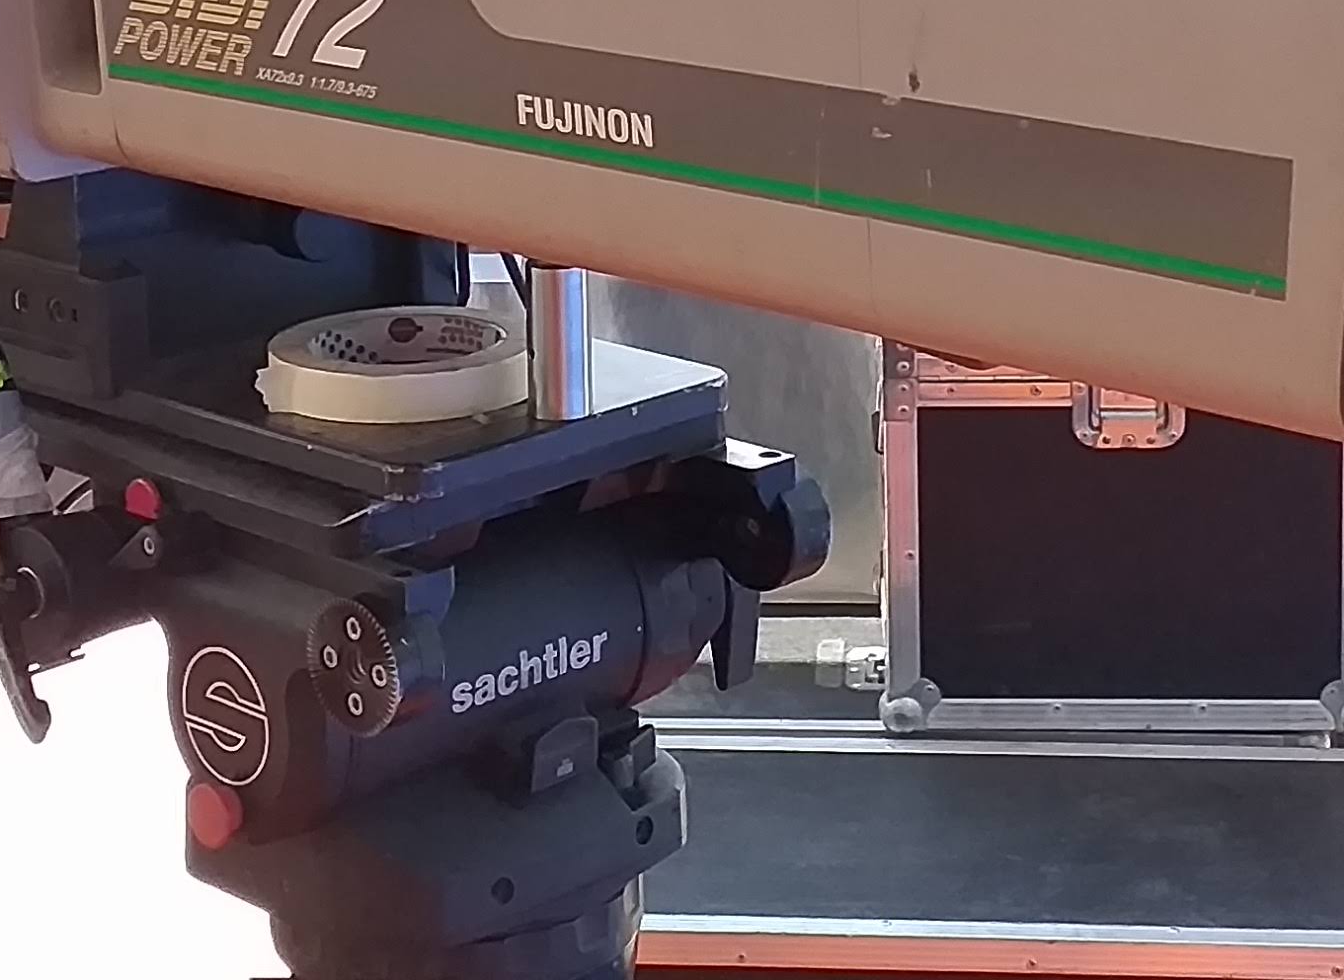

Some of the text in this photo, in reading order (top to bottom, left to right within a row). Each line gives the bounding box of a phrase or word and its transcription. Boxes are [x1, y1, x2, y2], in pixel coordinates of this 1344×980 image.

[113, 16, 253, 77] POWER
[516, 93, 654, 148] FUJINON
[451, 628, 609, 717] sachtler
